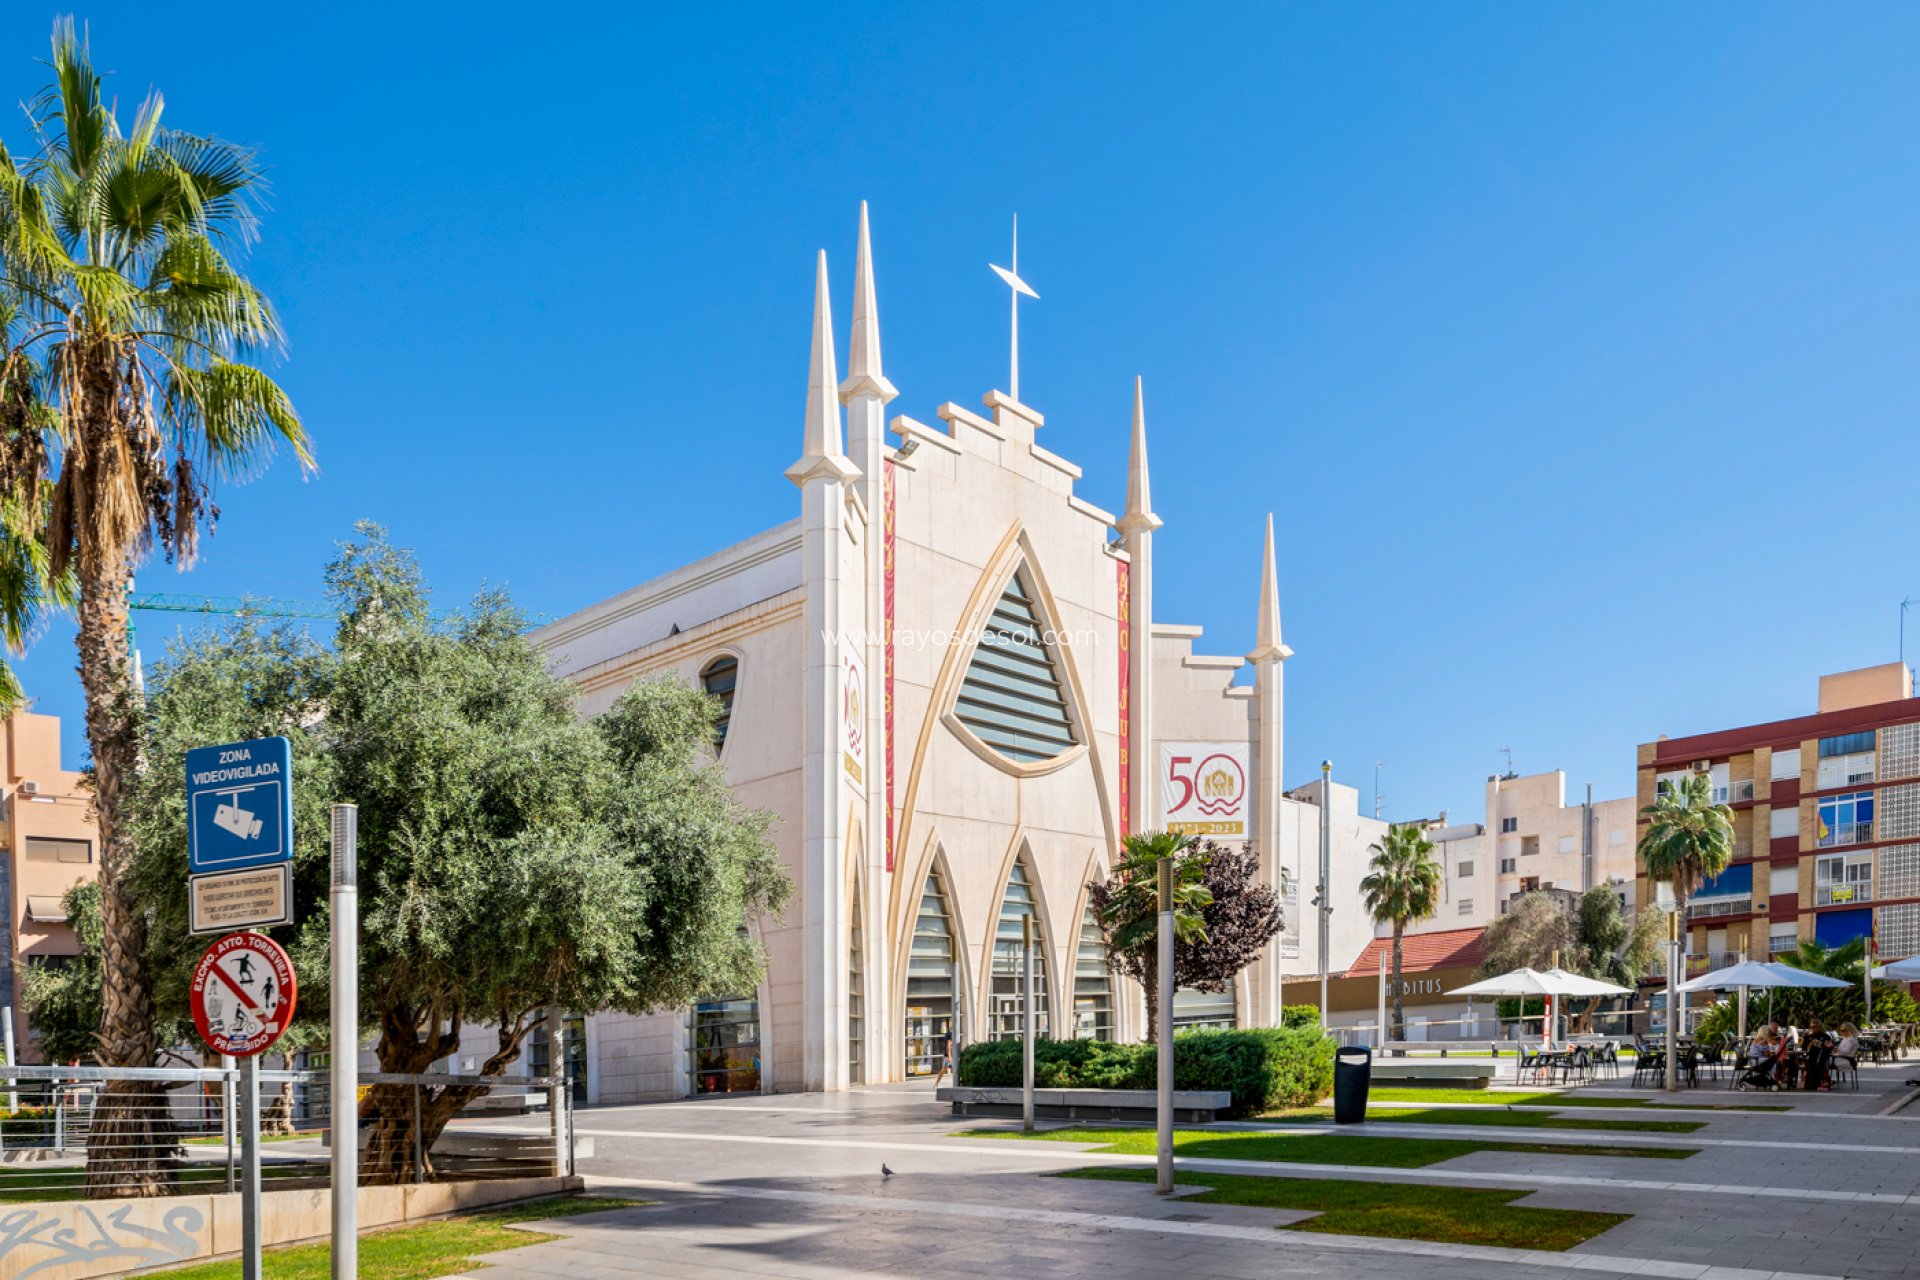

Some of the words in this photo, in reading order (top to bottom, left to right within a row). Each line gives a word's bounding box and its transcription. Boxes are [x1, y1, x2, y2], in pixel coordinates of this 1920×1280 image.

[219, 748, 252, 765] ZONA
[192, 762, 280, 785] VIDEOVIGILADA
[1118, 687, 1129, 876] JUBIL
[1167, 753, 1245, 815] 50
[1209, 822, 1236, 833] 2023
[194, 953, 218, 992] EXCMO.
[218, 936, 246, 953] AYTO.
[248, 937, 289, 986] TORREVIEJA
[1386, 979, 1441, 997] HBITUS
